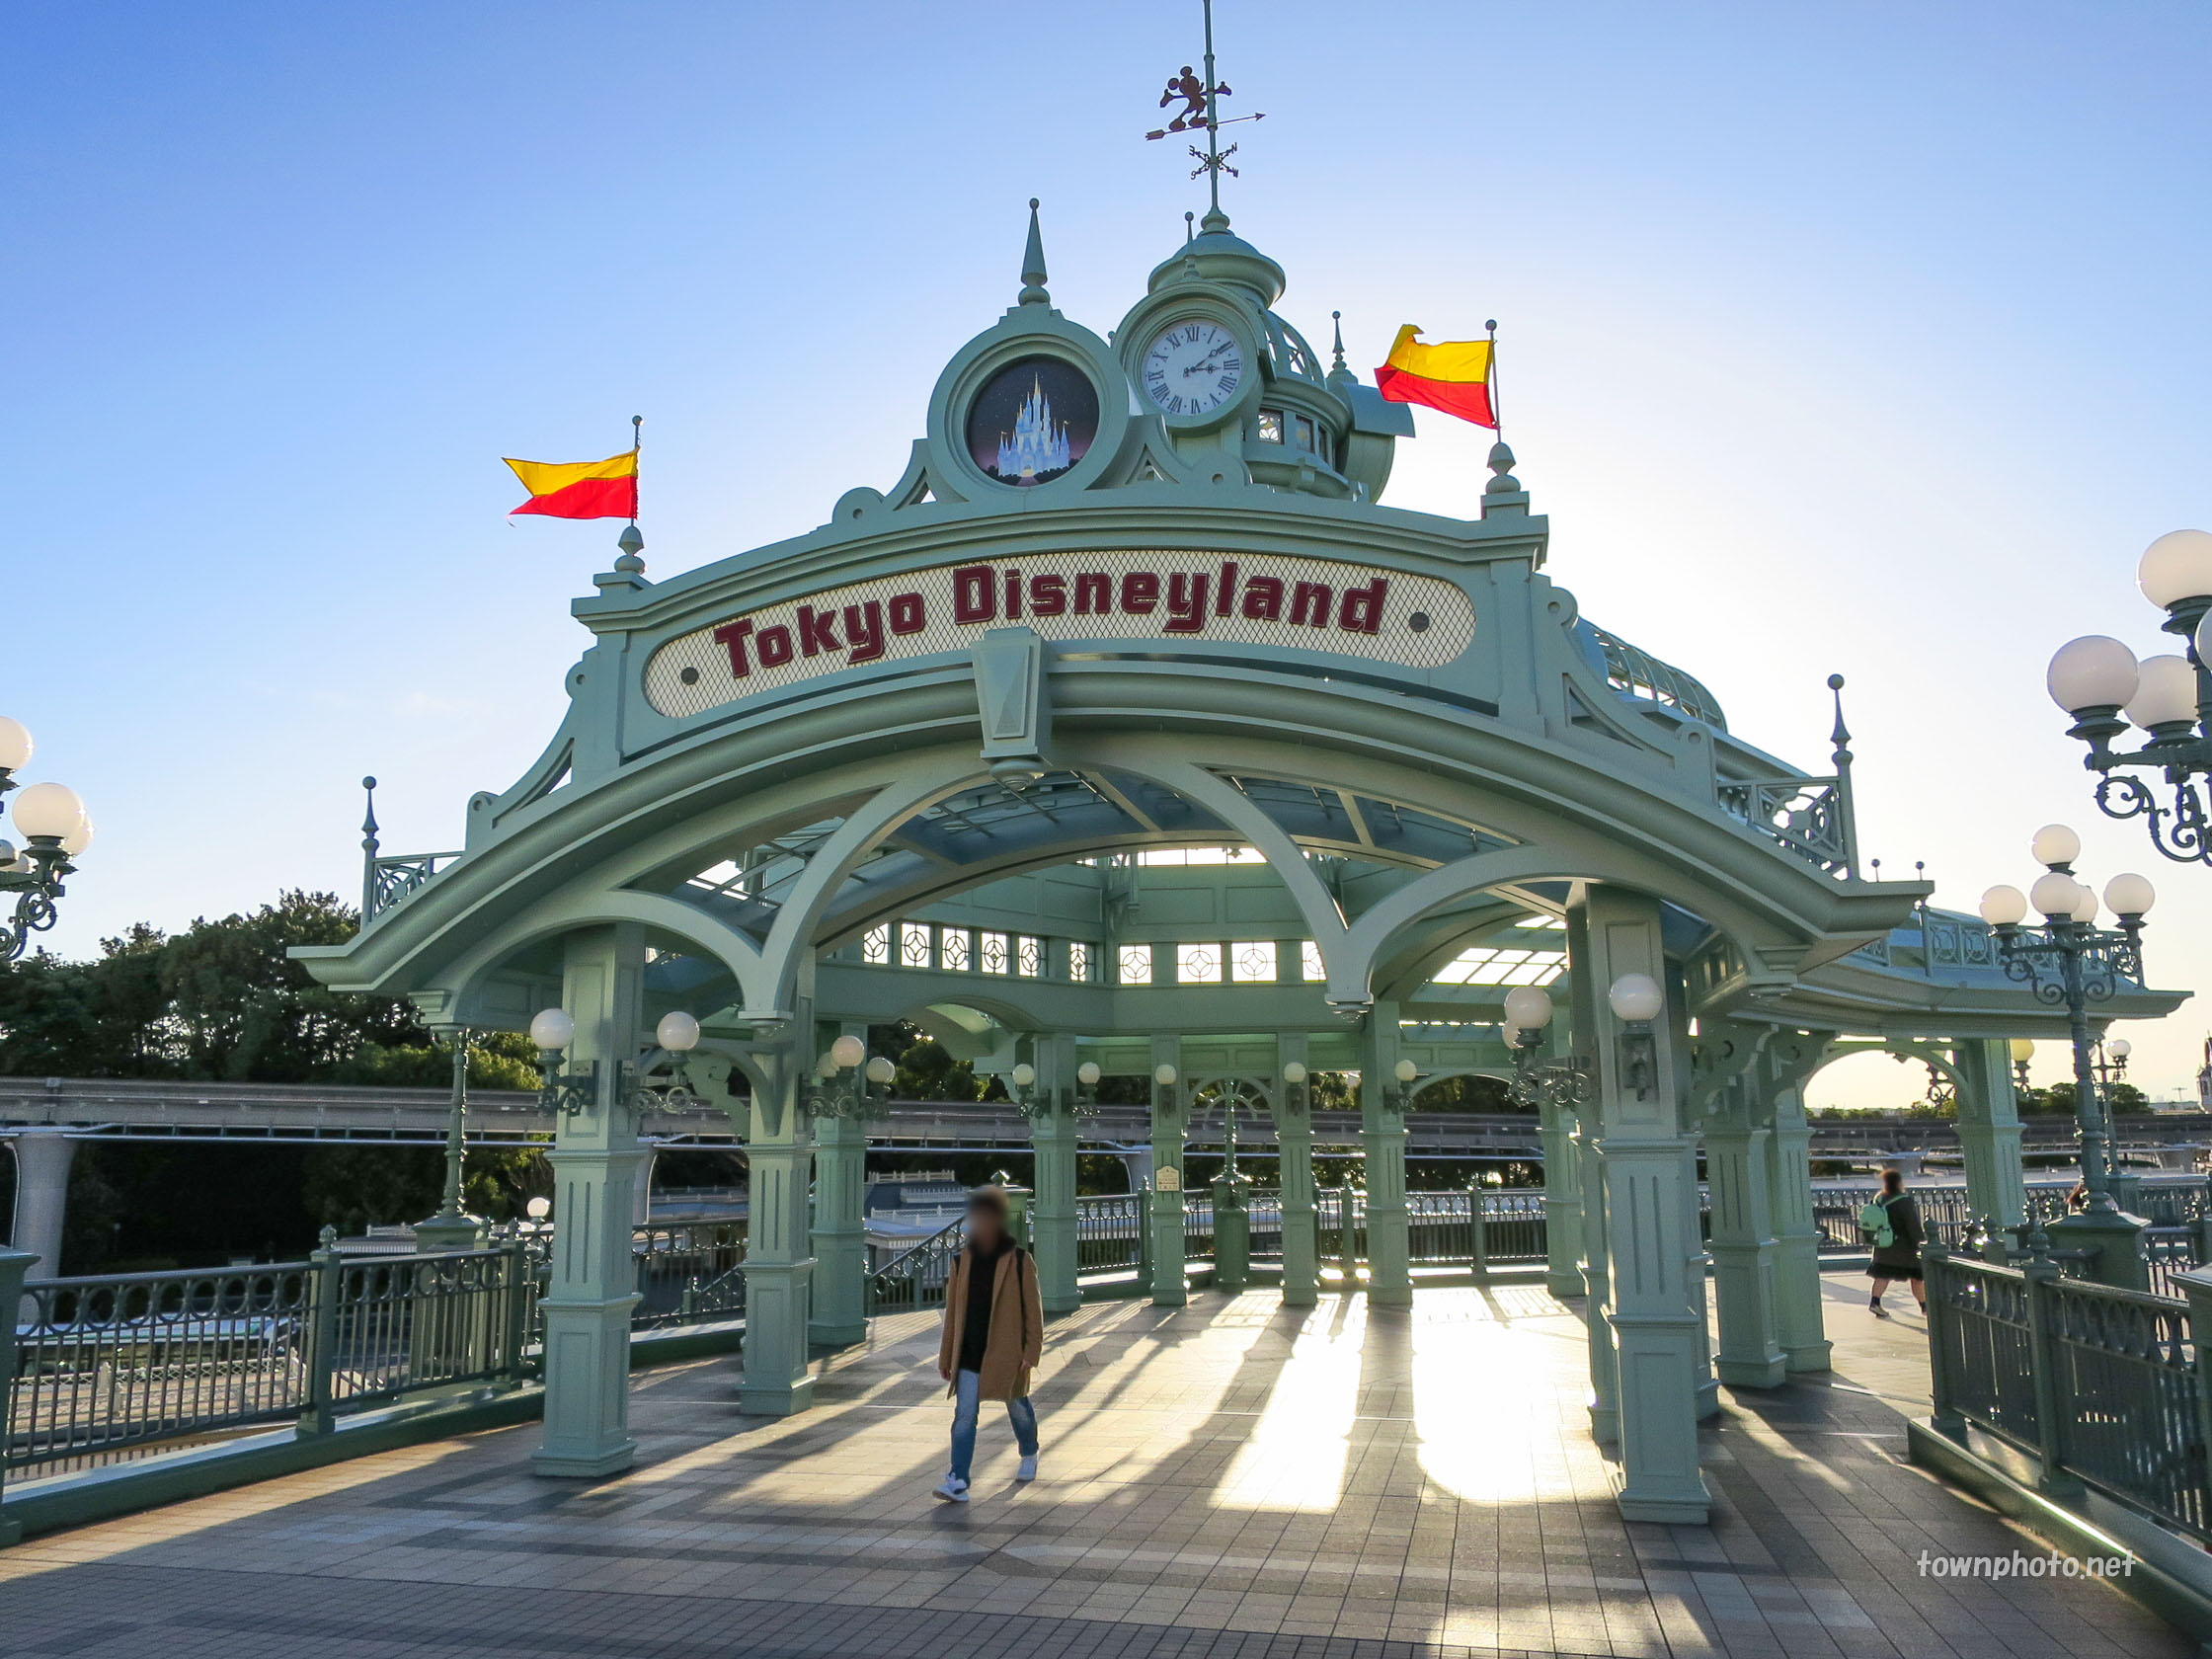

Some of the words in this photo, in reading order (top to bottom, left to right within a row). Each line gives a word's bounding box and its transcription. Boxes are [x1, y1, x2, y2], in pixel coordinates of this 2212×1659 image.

[1165, 332, 1181, 351] XI
[1185, 326, 1200, 343] XII
[1152, 352, 1169, 363] X
[1224, 358, 1240, 370] III
[1147, 369, 1164, 382] IX
[1167, 395, 1182, 413] VII
[1191, 399, 1201, 415] VI
[1210, 393, 1222, 408] V
[713, 592, 926, 678] Tokyo
[953, 561, 1387, 634] Disneyland
